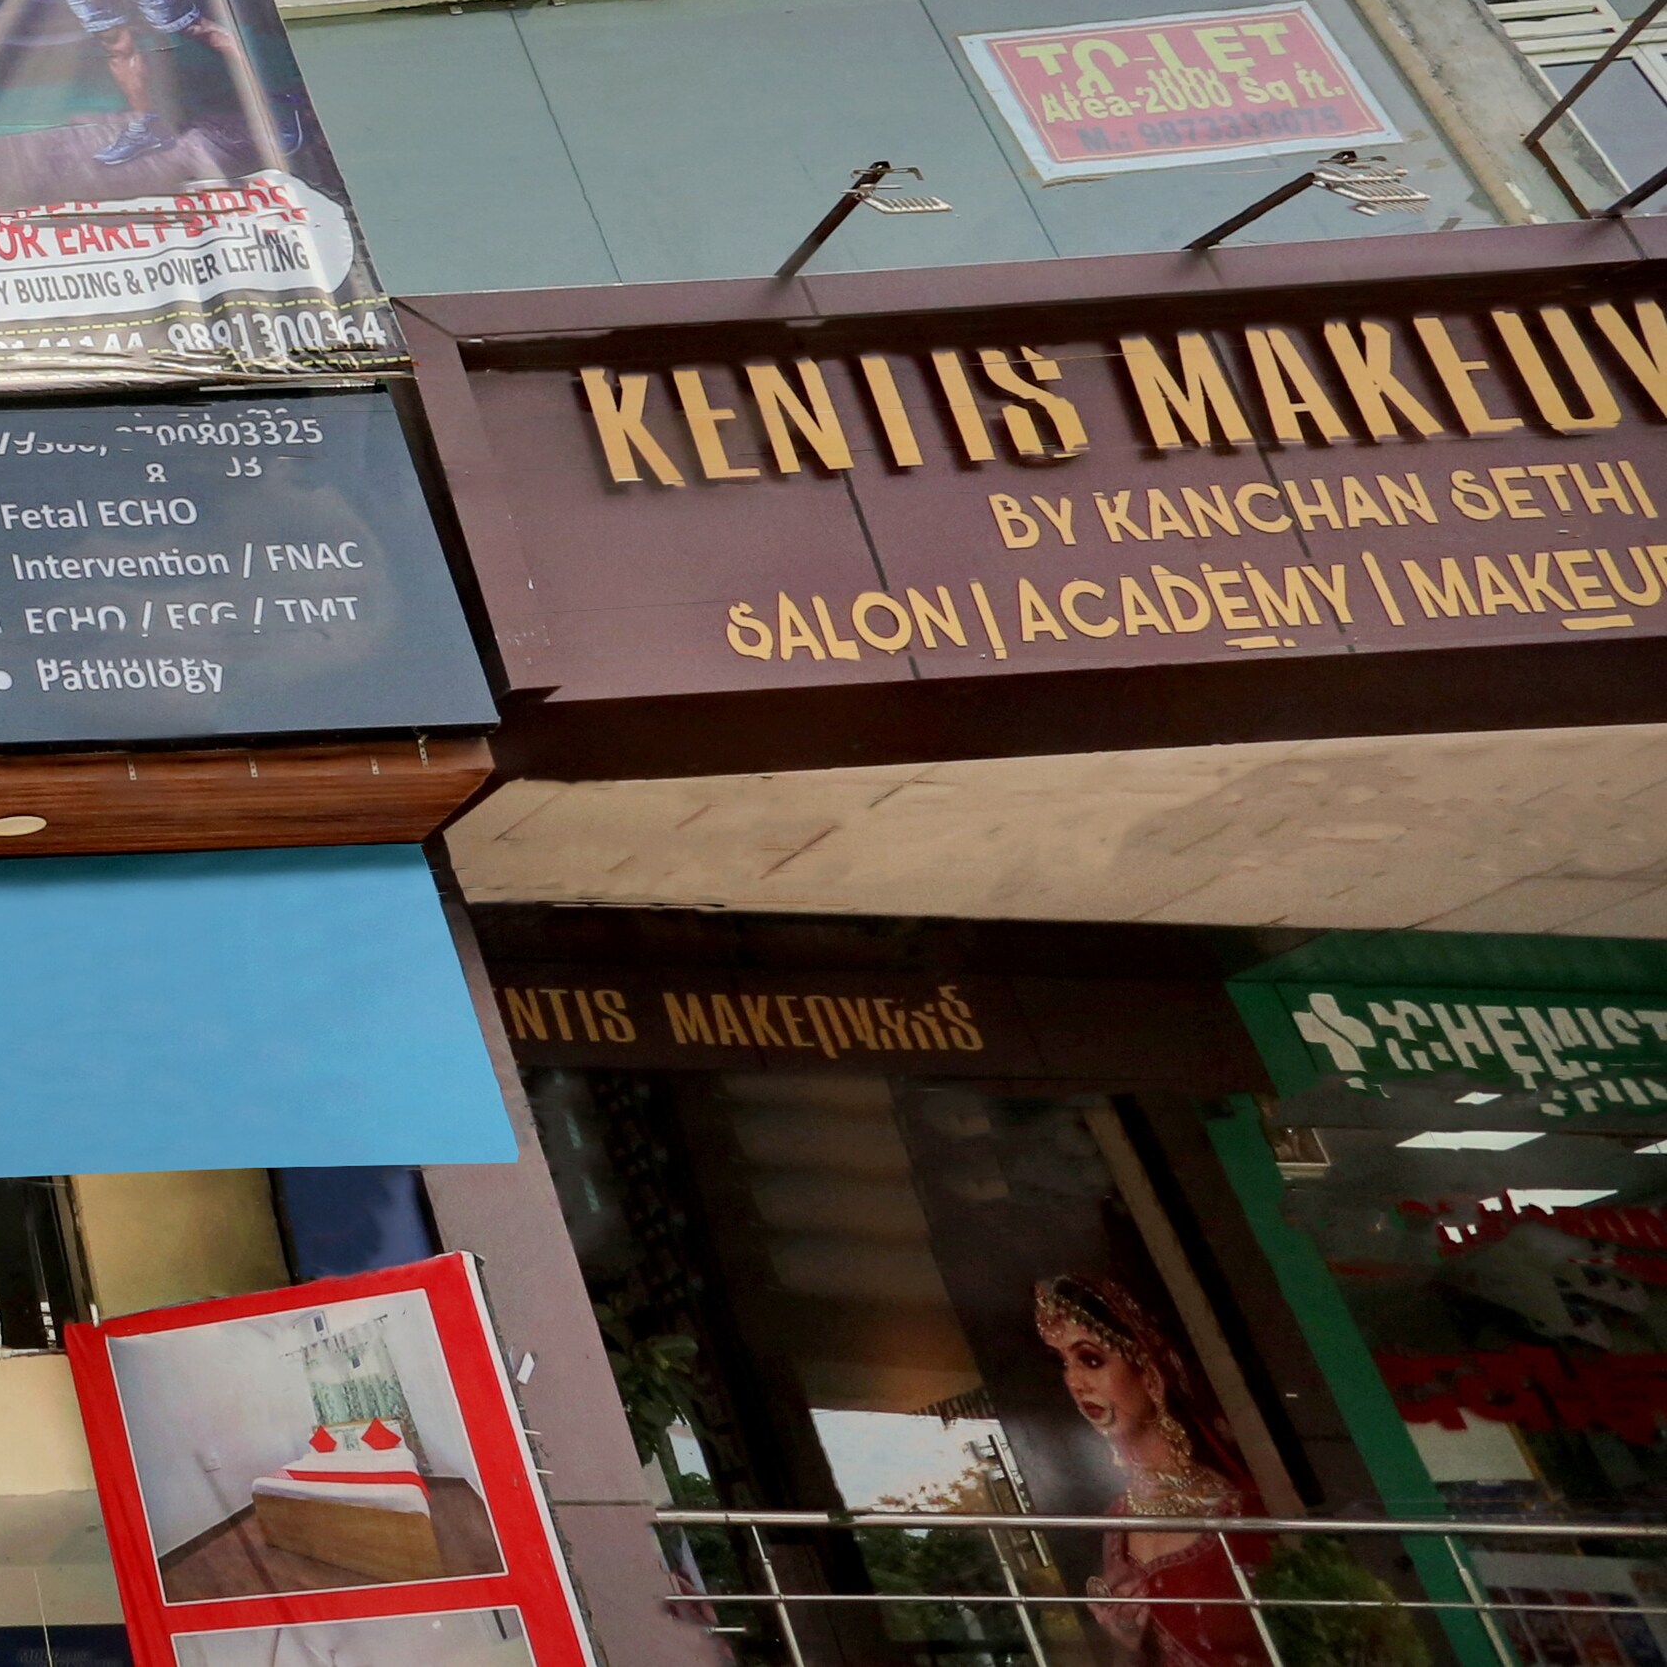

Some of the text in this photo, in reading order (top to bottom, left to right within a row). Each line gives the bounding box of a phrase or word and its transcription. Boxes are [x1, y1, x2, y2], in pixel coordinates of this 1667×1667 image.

[15, 269, 120, 304] BUILDING
[125, 269, 144, 294] &
[144, 252, 222, 291] POWER
[0, 497, 199, 531] Fetal ECHO
[987, 458, 1660, 551] BY KANCHAN SETHI
[11, 540, 365, 582] Intervention FNAC
[725, 583, 969, 662] SALON
[1016, 560, 1354, 644] ACADEMY
